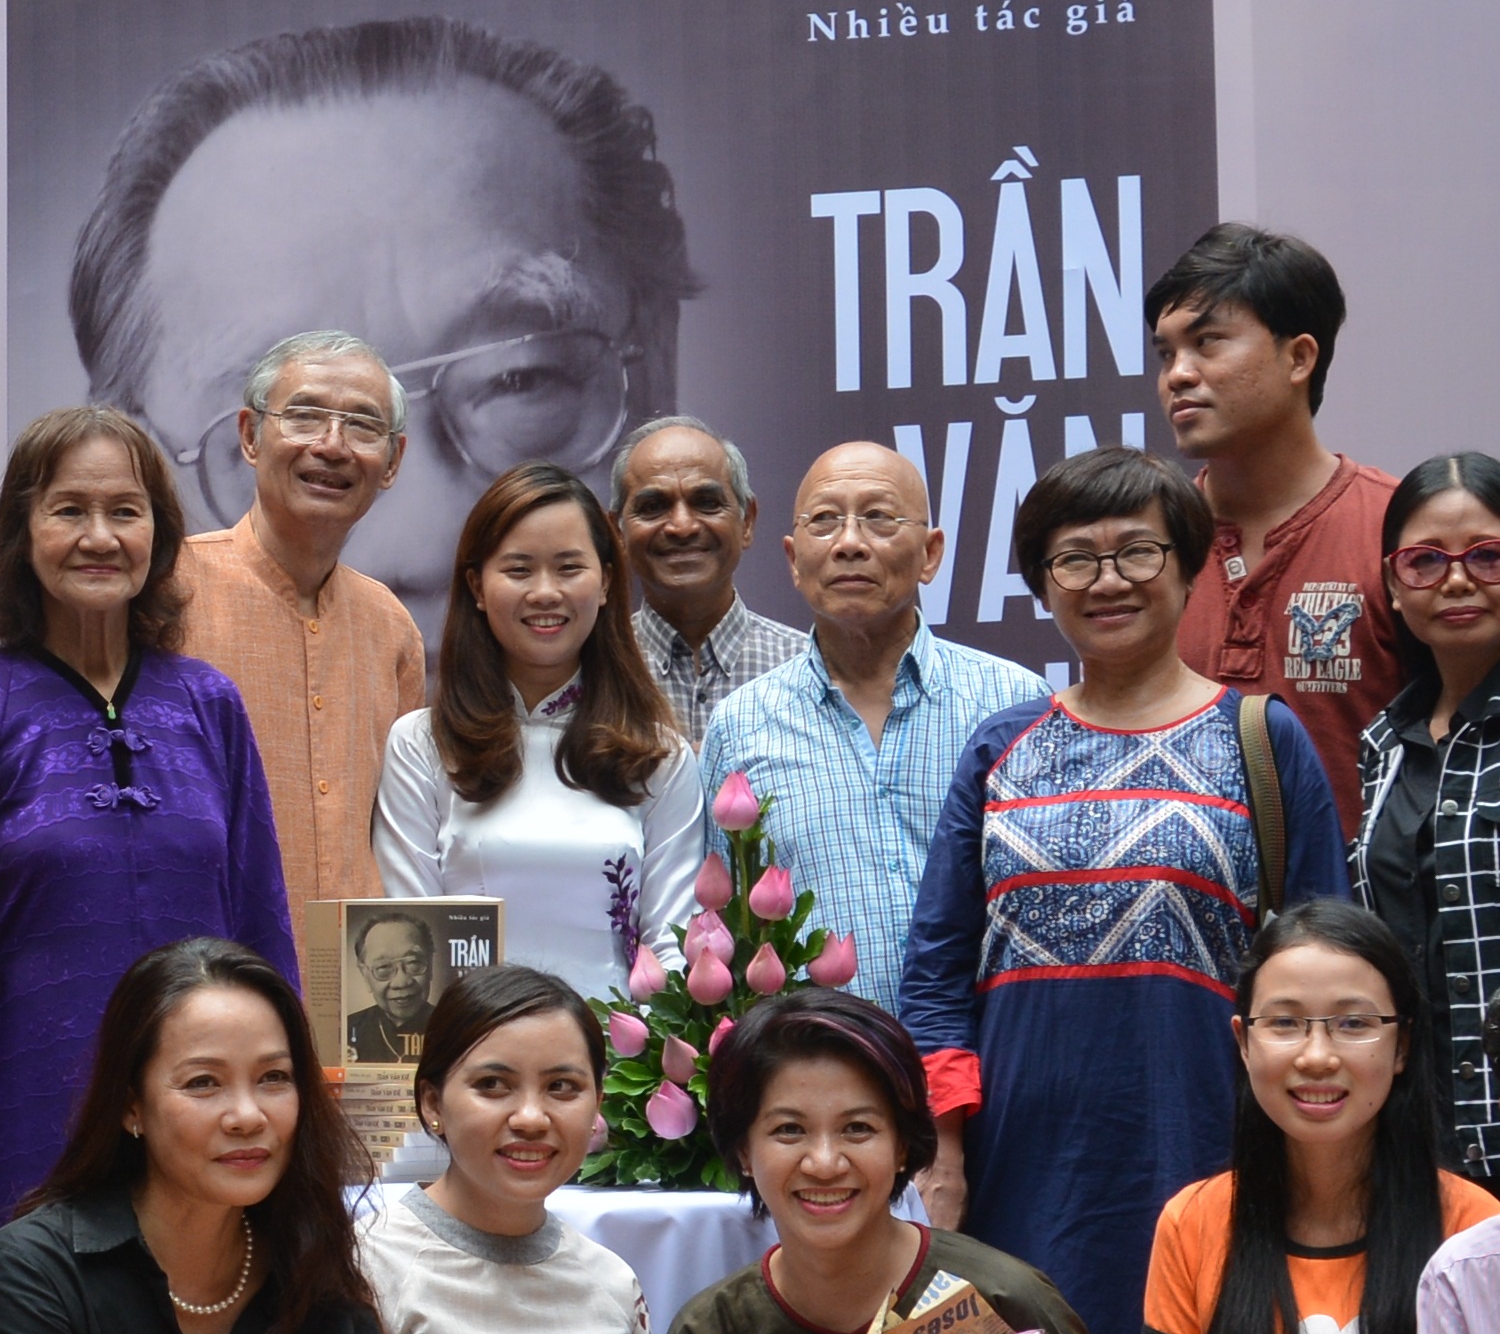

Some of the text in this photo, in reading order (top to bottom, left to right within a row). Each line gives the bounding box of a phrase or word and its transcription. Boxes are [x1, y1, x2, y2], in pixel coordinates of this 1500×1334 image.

[806, 1, 951, 43] Nhiều
[974, 0, 1041, 32] tác
[810, 146, 1145, 392] TRẦN
[1284, 656, 1362, 681] RED EAGLE
